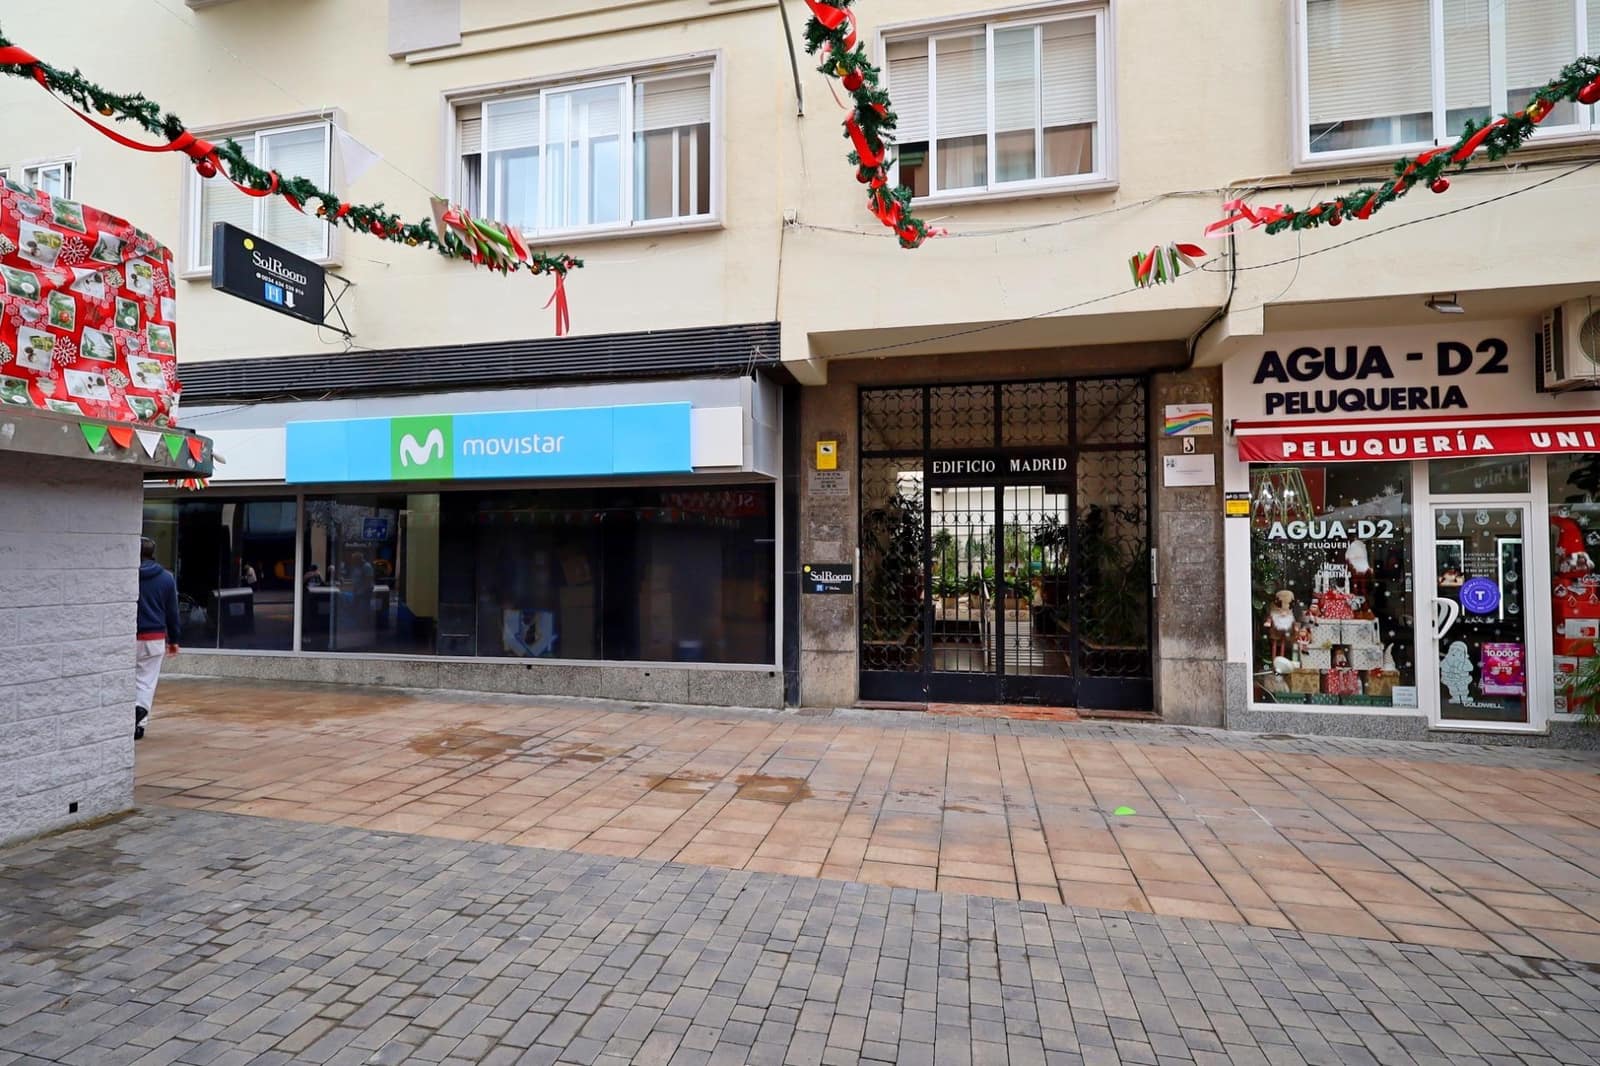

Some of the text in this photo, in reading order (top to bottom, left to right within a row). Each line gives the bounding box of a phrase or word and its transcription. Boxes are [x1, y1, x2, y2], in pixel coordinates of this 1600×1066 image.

[252, 250, 307, 285] SolRoom
[1253, 346, 1394, 384] AGUA
[1437, 338, 1509, 376] D2
[1265, 385, 1468, 415] PELUQUERIA
[463, 433, 565, 456] movistar
[1282, 430, 1596, 457] PELUQUERÍA UNI
[932, 458, 1067, 474] EDIFICIO MADRID
[1267, 520, 1394, 540] AGUA-D2
[810, 571, 852, 582] SolRoom
